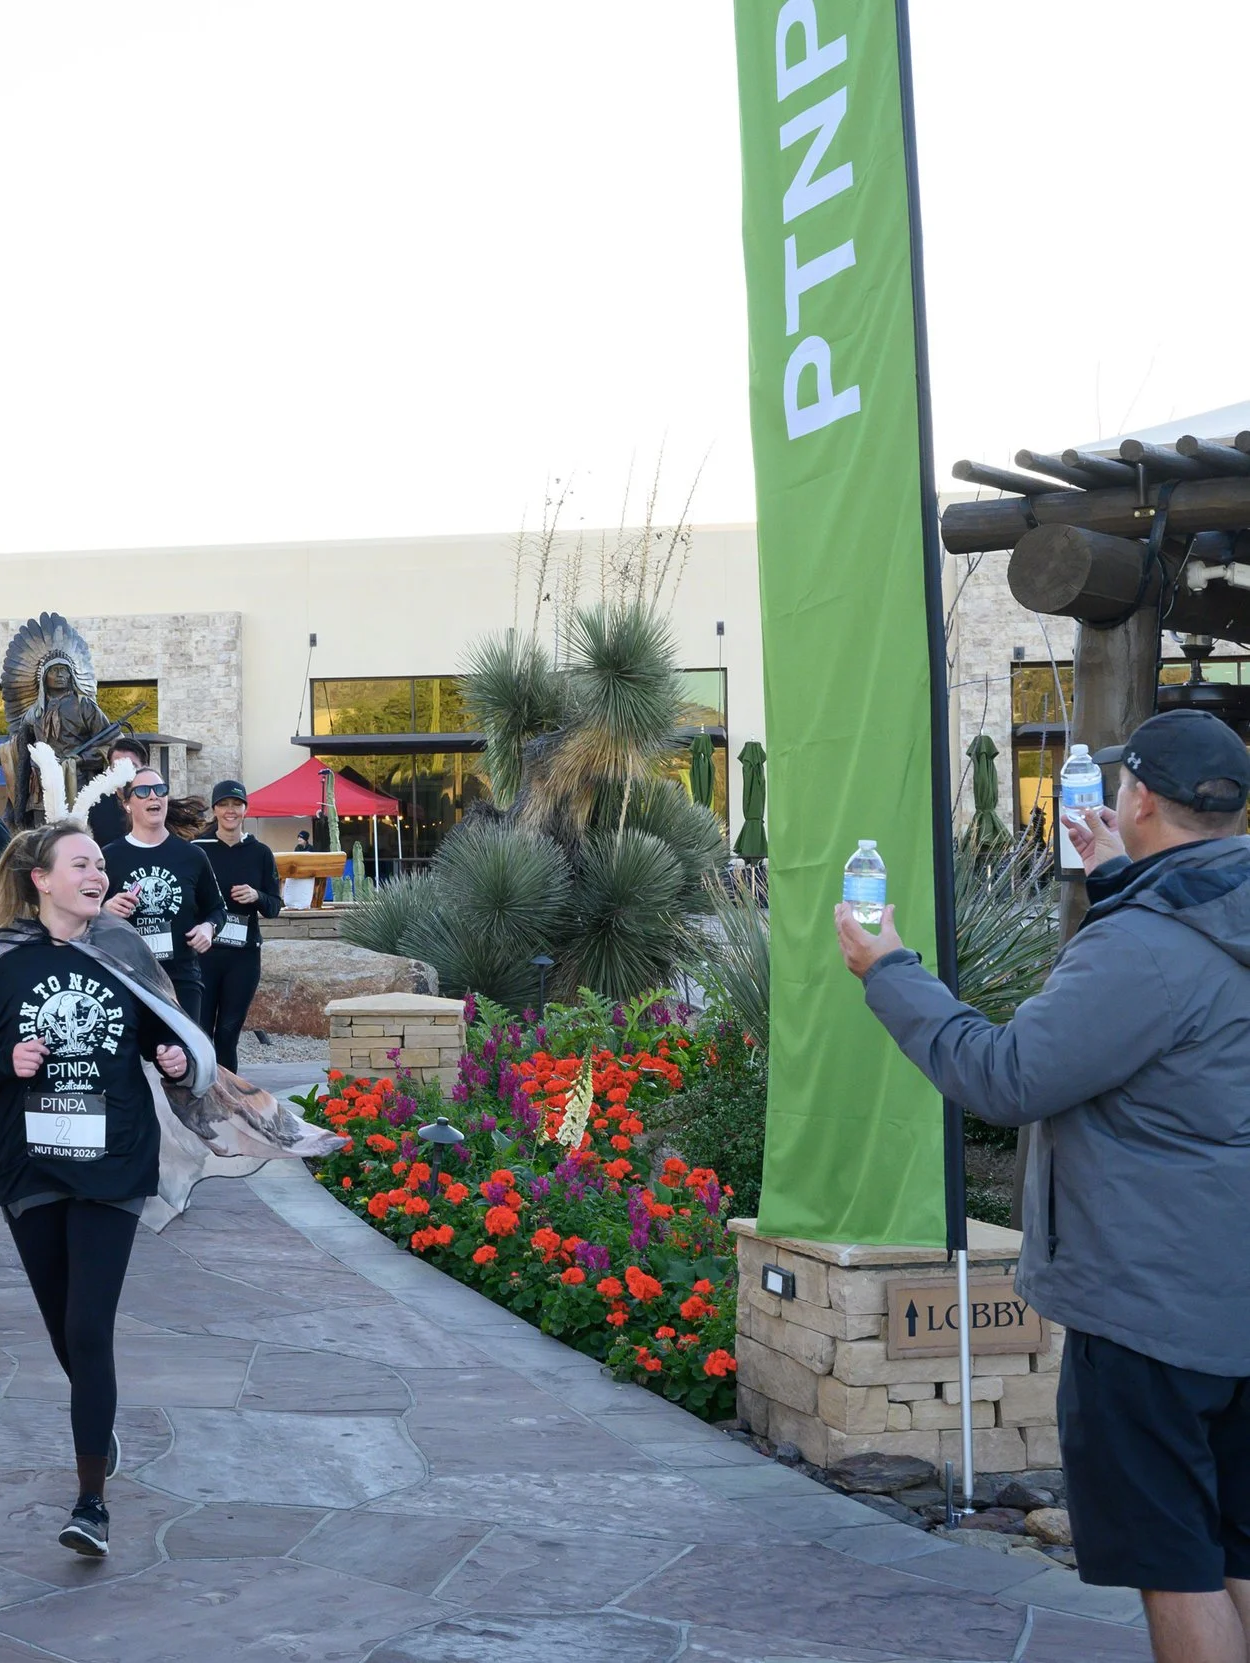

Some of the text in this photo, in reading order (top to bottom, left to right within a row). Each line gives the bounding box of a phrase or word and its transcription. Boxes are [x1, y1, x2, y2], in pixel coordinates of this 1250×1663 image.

[776, 0, 862, 441] PTNP
[130, 865, 182, 915] TO NUT RUN
[226, 914, 240, 924] NPA
[19, 972, 125, 1056] RN TO NUT RUN
[46, 1060, 100, 1079] PTNPA
[54, 1079, 94, 1093] Scottsdale
[40, 1097, 87, 1113] PTNPA
[55, 1115, 72, 1145] 2
[34, 1145, 97, 1158] NUT RUN 2026
[926, 1300, 1029, 1331] LOBBY
